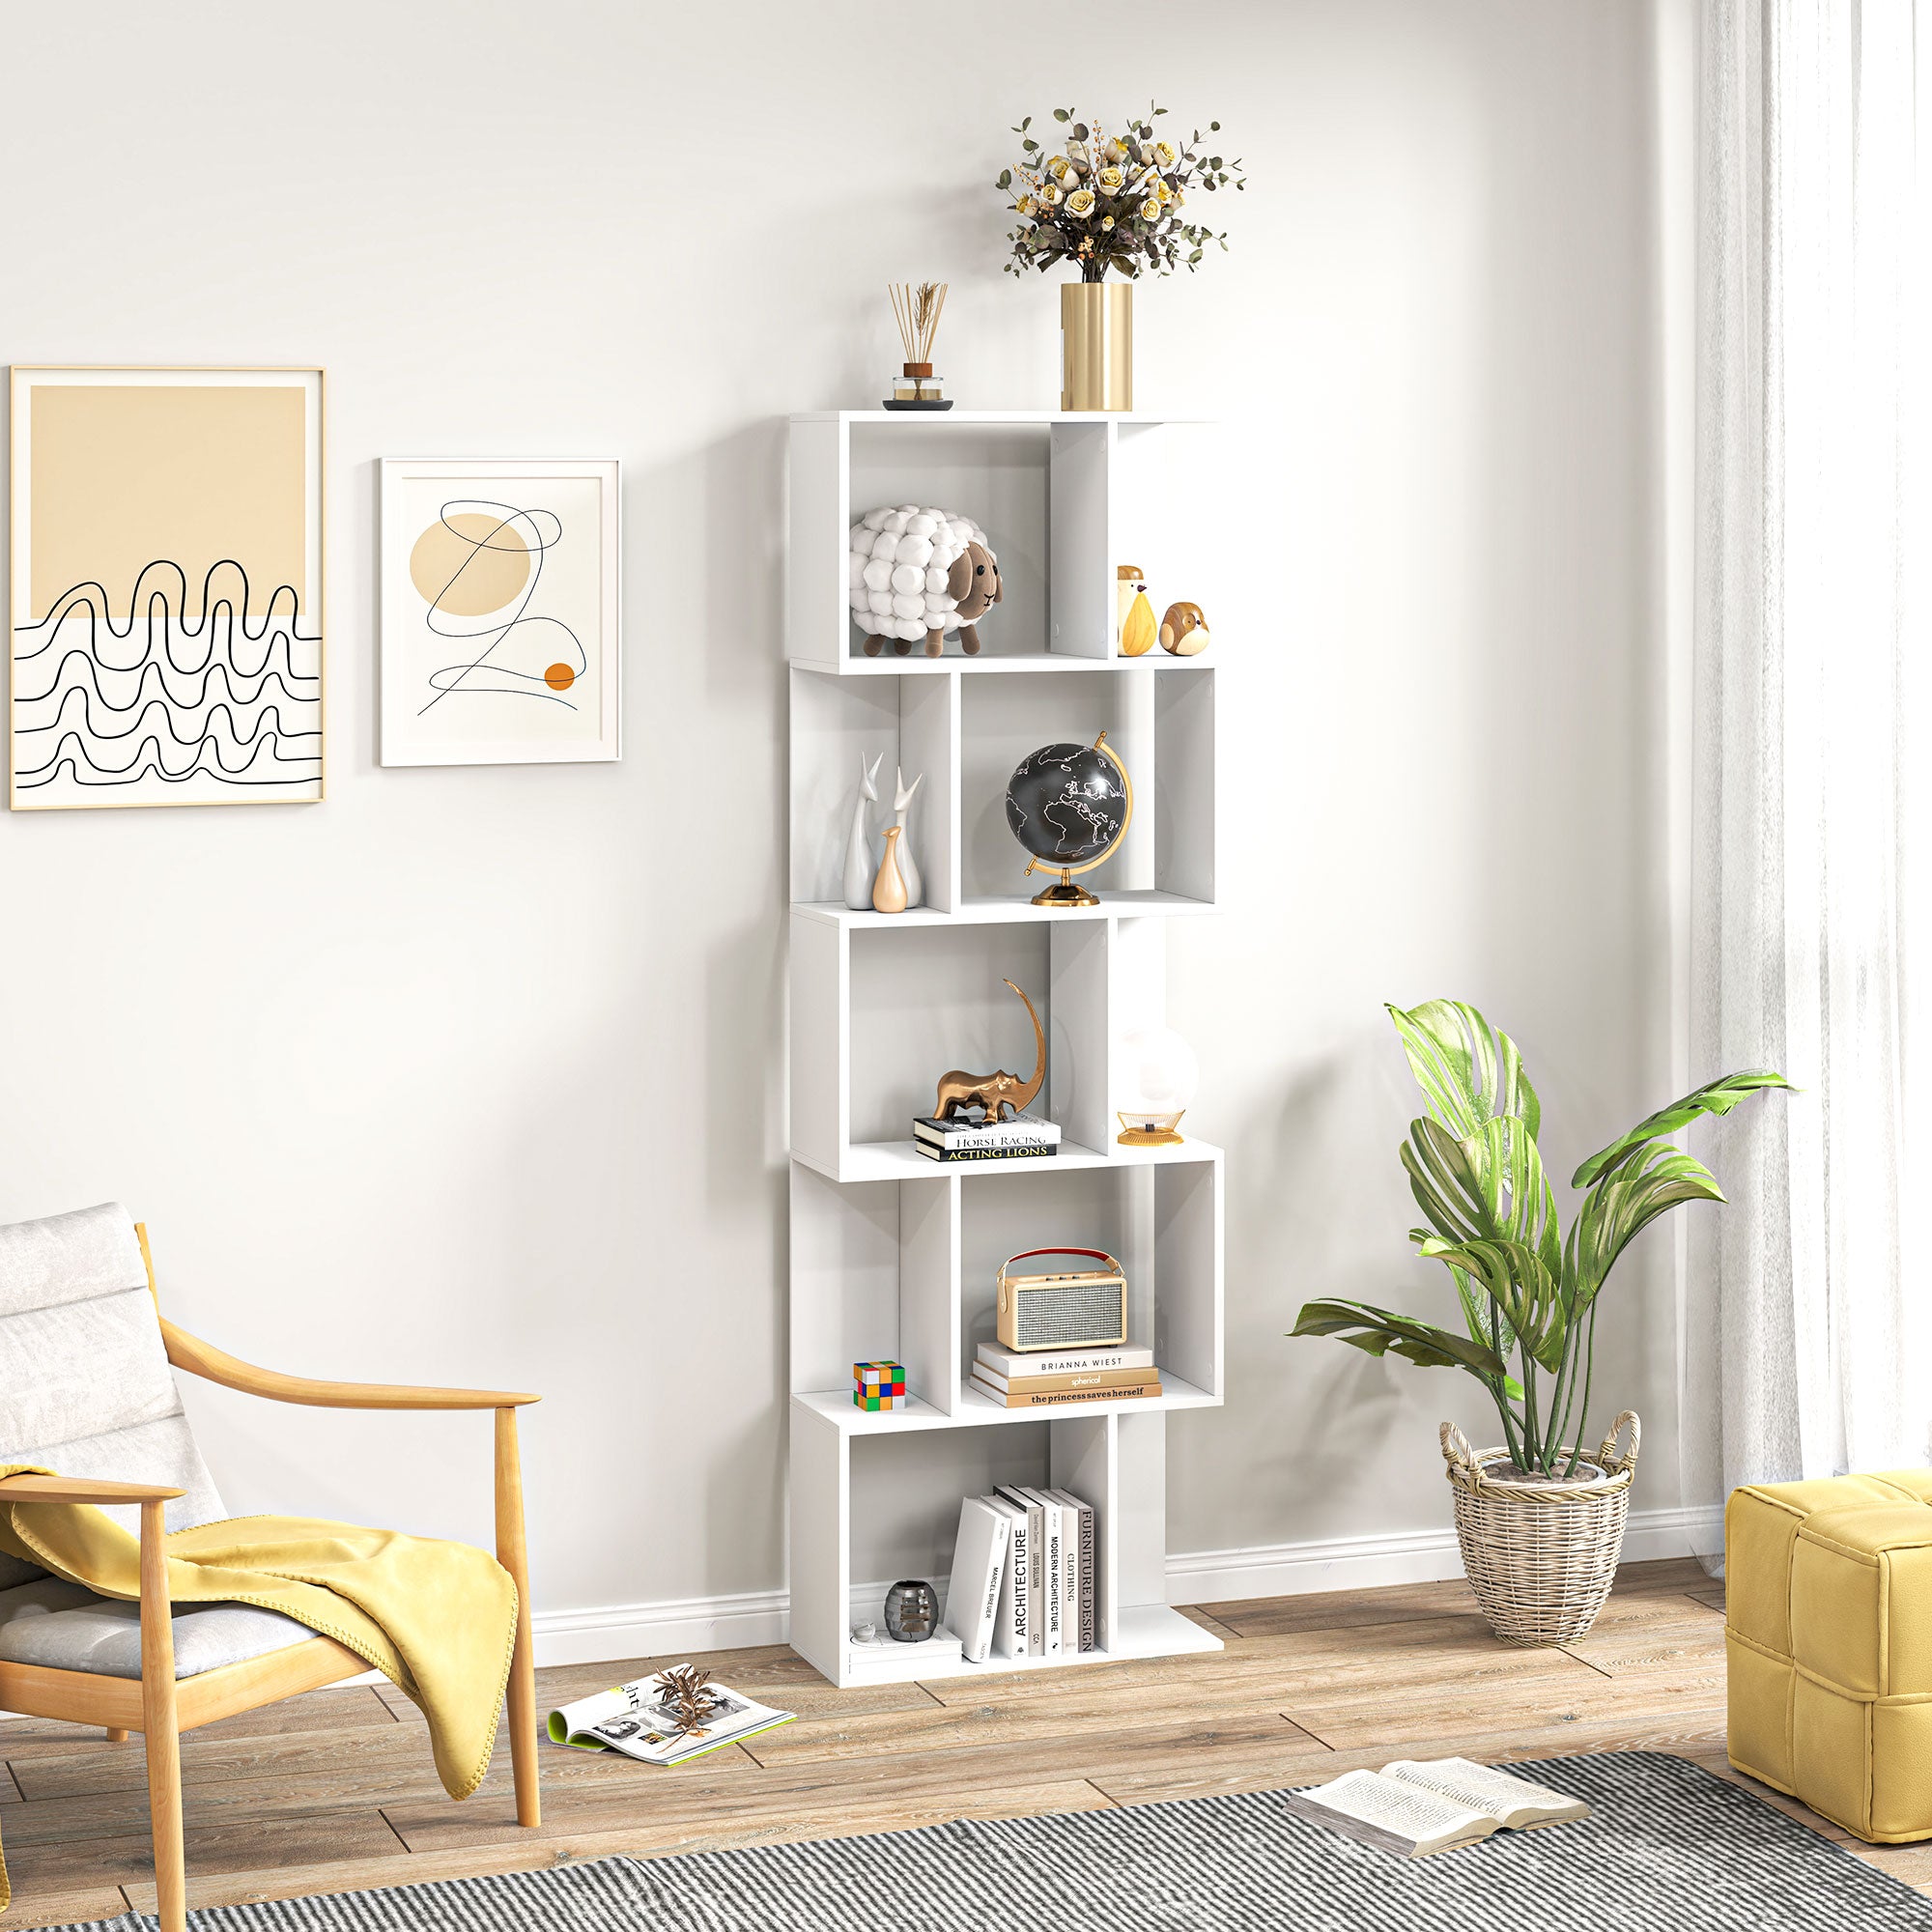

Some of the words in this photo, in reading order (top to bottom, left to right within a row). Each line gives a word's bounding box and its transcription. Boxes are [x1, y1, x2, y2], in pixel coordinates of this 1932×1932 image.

[1001, 1136, 1046, 1146] RACING
[948, 1149, 1002, 1160] ACTING
[1007, 1147, 1047, 1156] LIONS
[1041, 1361, 1088, 1371] BRIANNA
[1092, 1357, 1122, 1367] WIEST
[1071, 1375, 1101, 1386] spherical
[1032, 1395, 1047, 1404] the
[1047, 1392, 1087, 1405] princess
[1112, 1387, 1144, 1398] herself
[1083, 1511, 1092, 1595] FURNITURE
[989, 1567, 999, 1592] MARCEL
[1015, 1528, 1026, 1636] ARCHITECTURE
[985, 1593, 996, 1619] BREUER
[1083, 1600, 1092, 1652] DESIGN
